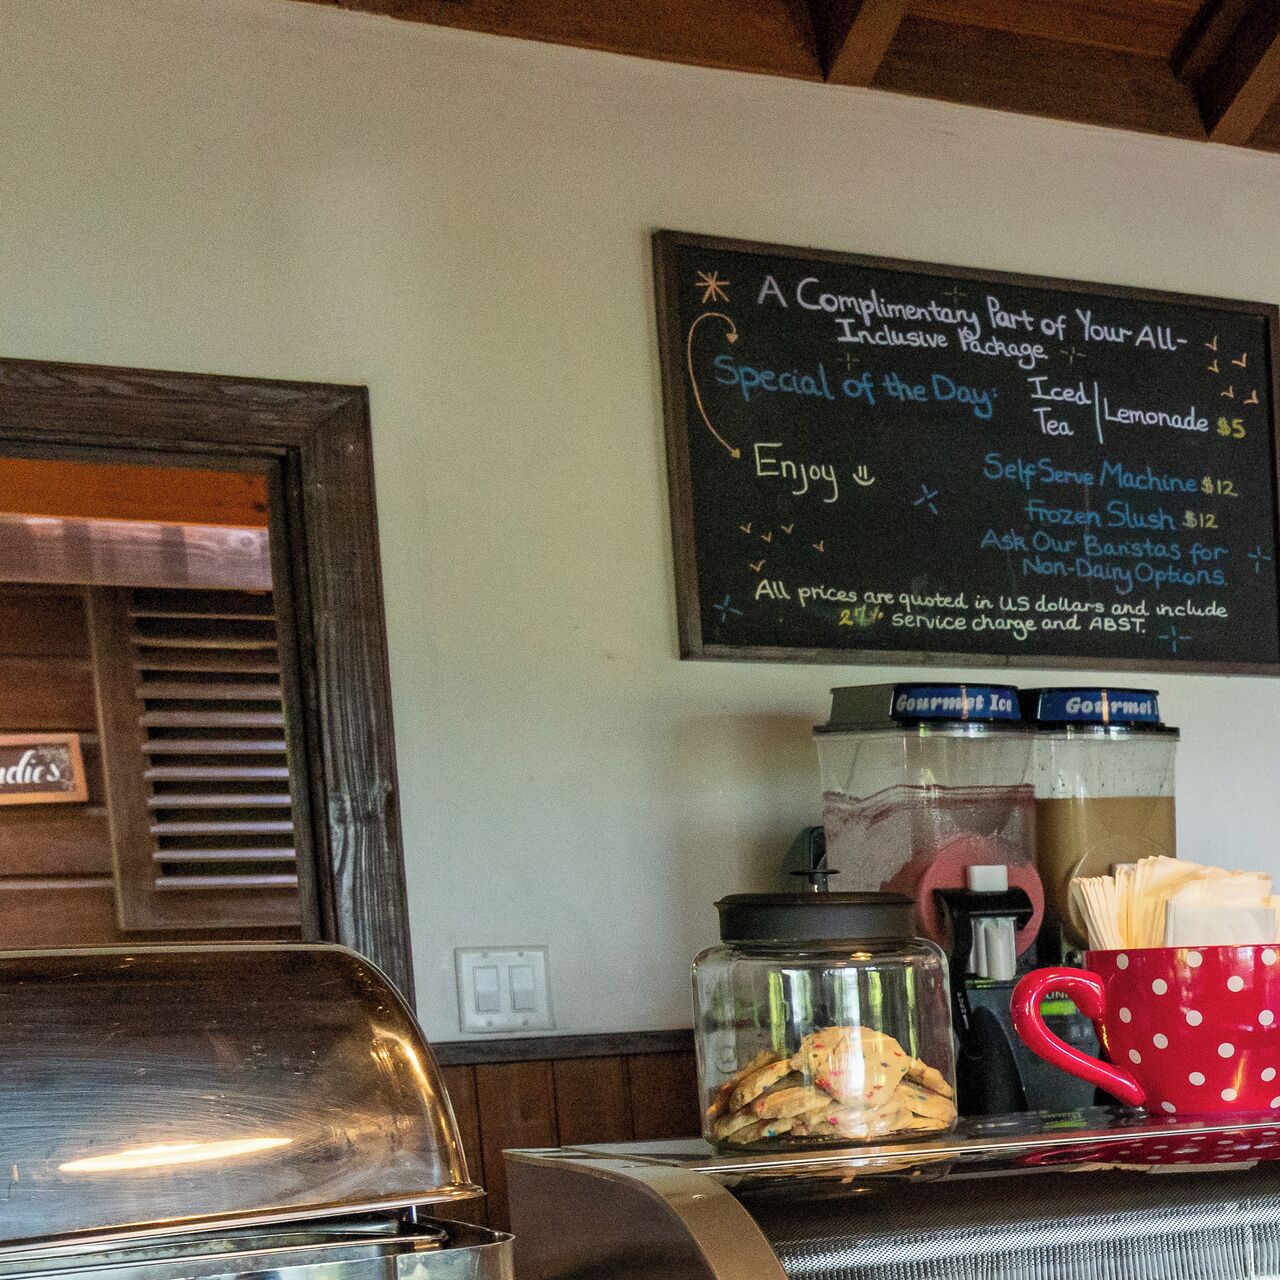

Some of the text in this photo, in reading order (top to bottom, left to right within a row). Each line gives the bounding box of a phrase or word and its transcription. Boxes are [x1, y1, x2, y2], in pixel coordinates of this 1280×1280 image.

[757, 275, 788, 307] A
[797, 277, 981, 339] Complimentary
[987, 296, 1034, 331] Part
[1041, 315, 1067, 341] of
[1076, 308, 1132, 341] Your
[835, 318, 949, 347] Inclusive
[714, 354, 834, 401] Special
[843, 371, 876, 405] of
[882, 371, 929, 402] the
[1028, 376, 1092, 405] Iced
[1033, 407, 1074, 436] Tea
[1104, 398, 1247, 438] Lemonade $5
[754, 443, 839, 503] Enjoy
[1100, 460, 1198, 493] Machine
[1201, 476, 1238, 497] $12
[1024, 499, 1218, 530] Frozen Slush $12
[980, 528, 1230, 566] Ask Our Baristas for
[1022, 556, 1133, 595] Non-Dairy
[755, 579, 1229, 618] All prices are quoted in US dollars and include
[892, 612, 967, 629] service
[972, 613, 1037, 641] charge
[1041, 614, 1081, 631] and
[989, 694, 1012, 713] Ice
